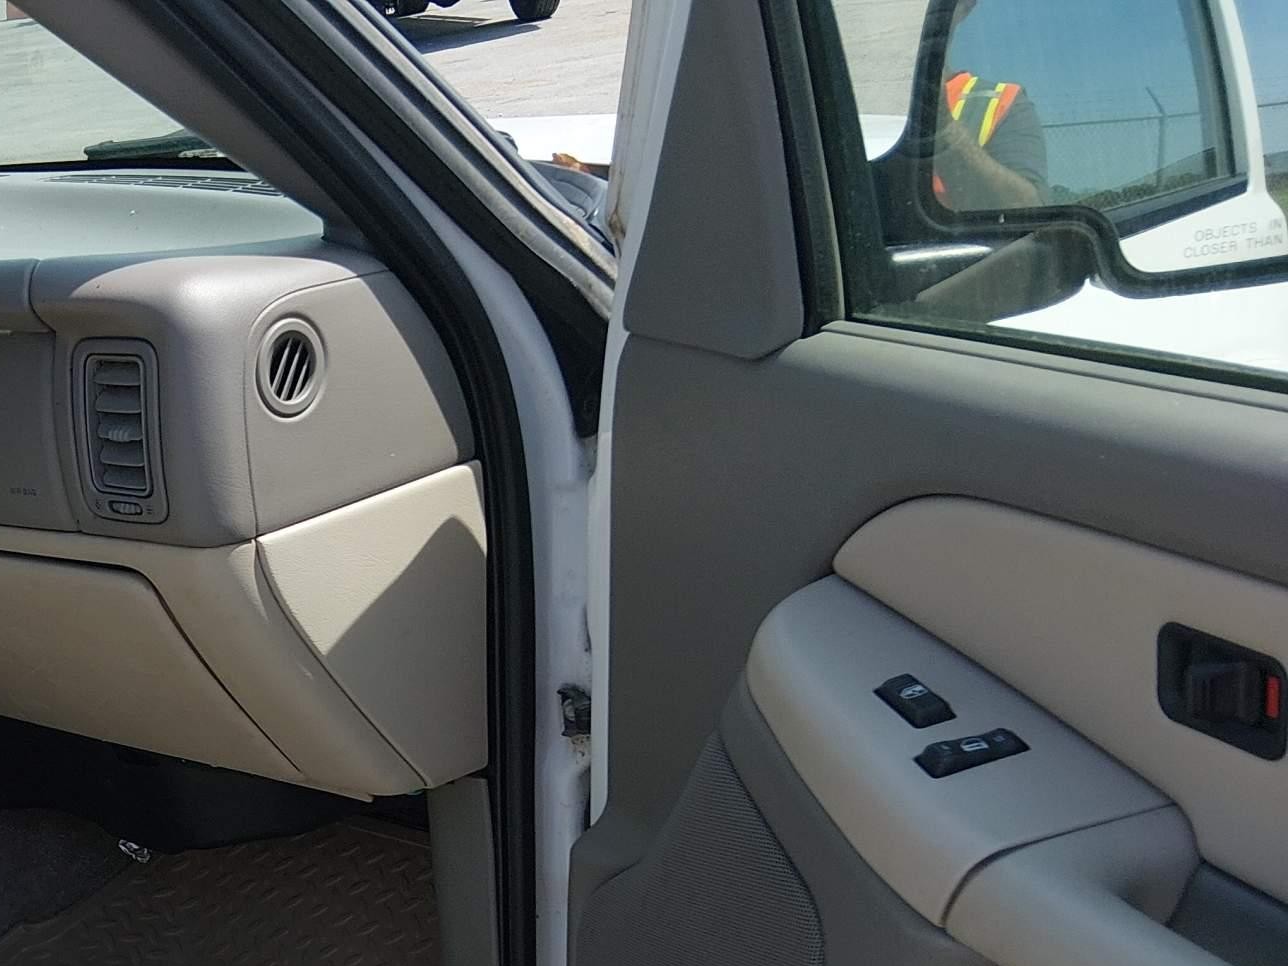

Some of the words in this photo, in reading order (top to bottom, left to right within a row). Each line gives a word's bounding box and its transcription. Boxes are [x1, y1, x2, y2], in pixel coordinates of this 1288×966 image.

[1194, 222, 1257, 242] OBJECTS
[1269, 218, 1283, 230] IN
[1184, 240, 1238, 258] CLOSER
[1245, 234, 1284, 249] THAN
